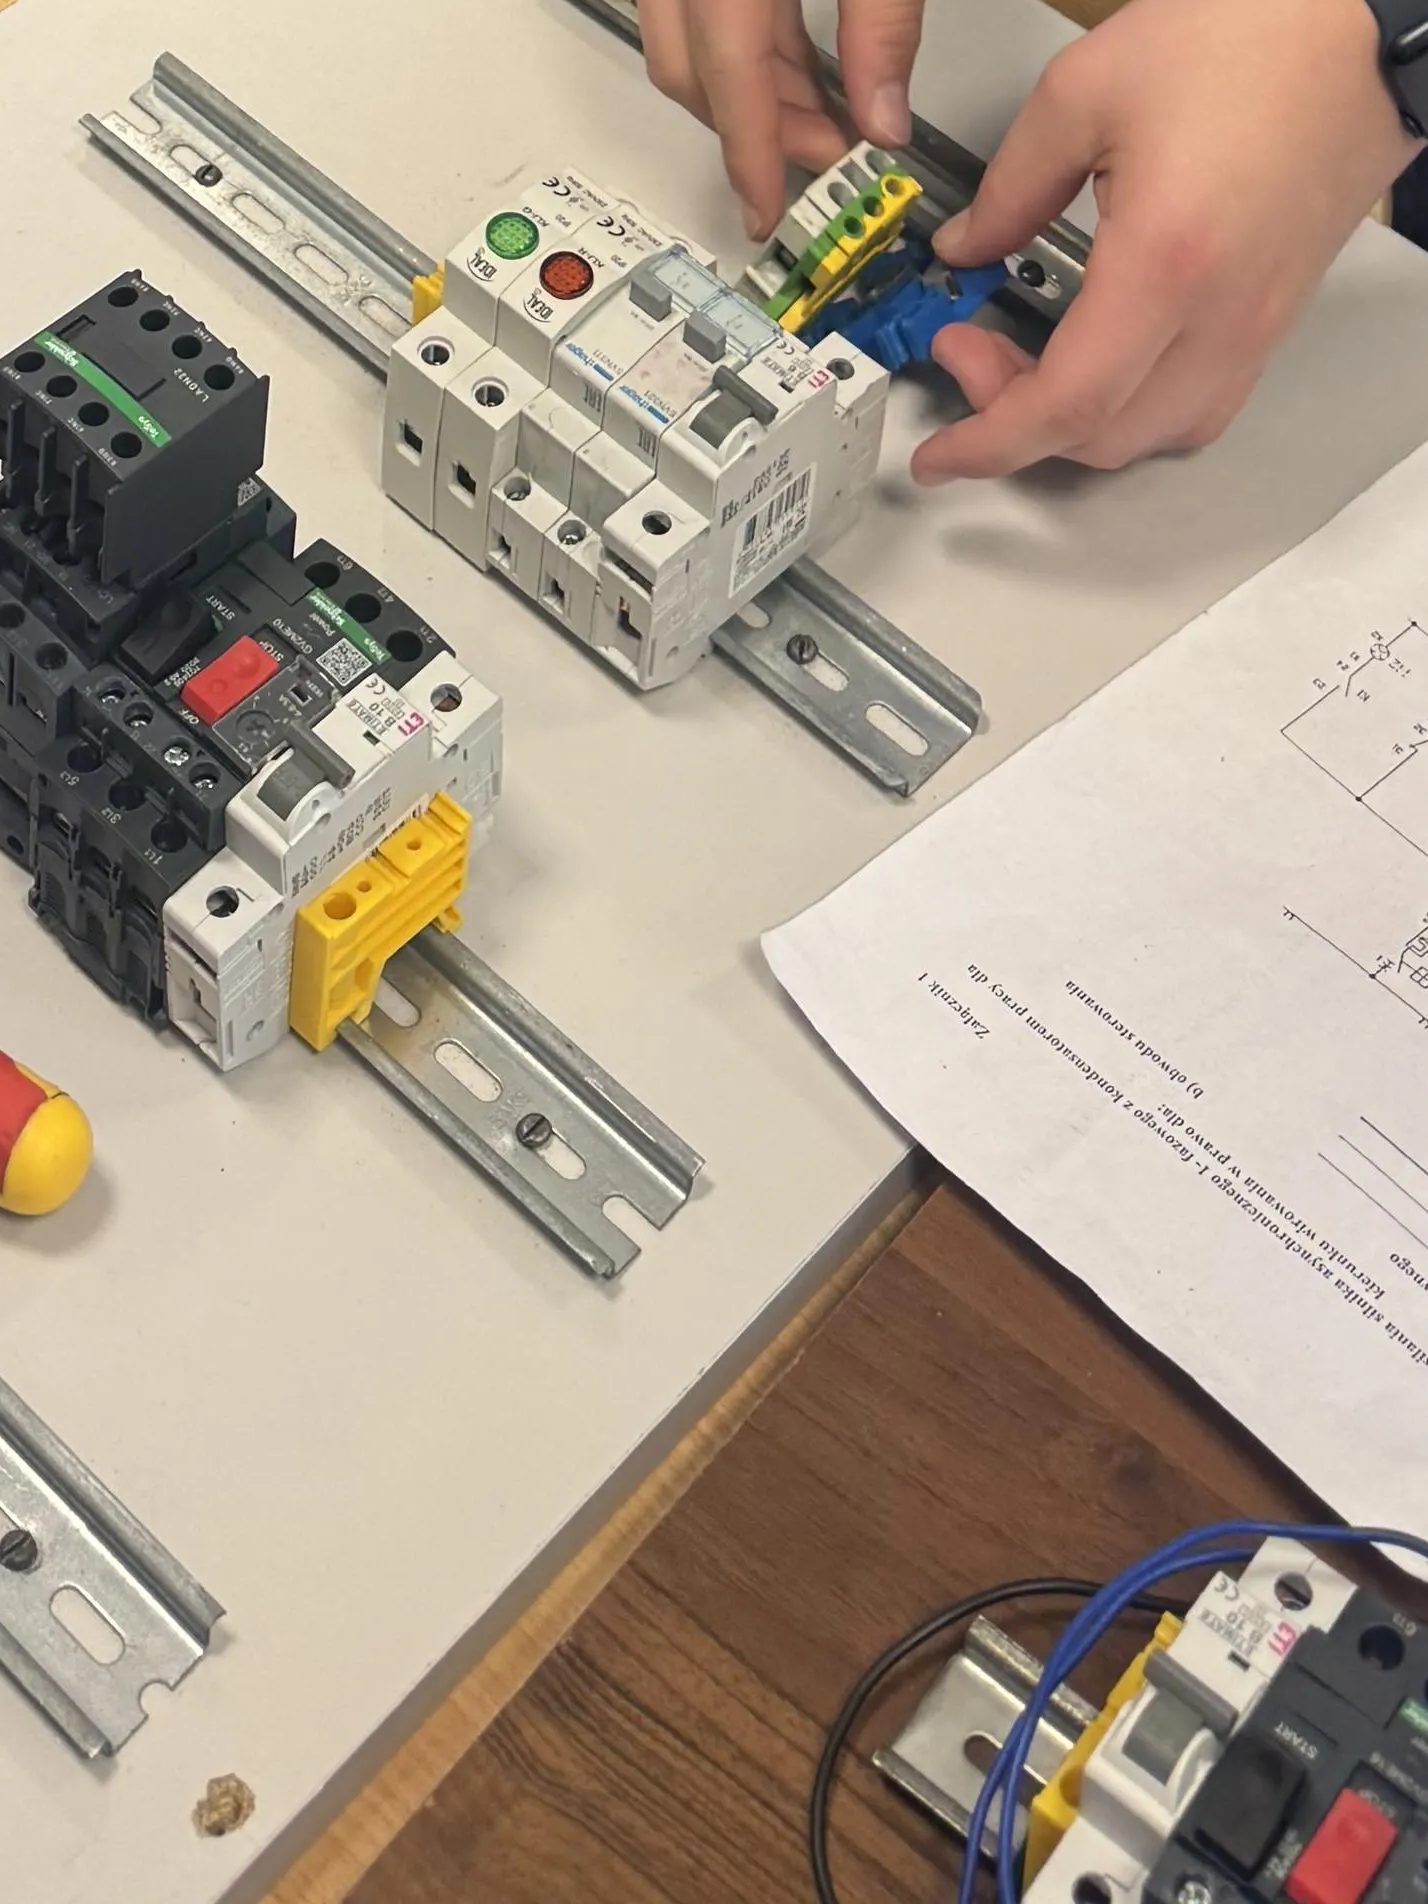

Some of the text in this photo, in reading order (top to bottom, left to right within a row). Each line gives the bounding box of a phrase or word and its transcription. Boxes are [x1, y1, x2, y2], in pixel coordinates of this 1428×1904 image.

[467, 251, 498, 280] IDEAL
[524, 292, 554, 320] IDEAL
[204, 592, 237, 620] START
[177, 705, 201, 726] OFF
[367, 699, 386, 717] 10
[395, 708, 425, 739] ETI
[968, 965, 988, 982] dla
[989, 984, 1028, 1016] pracy
[1066, 981, 1135, 1040] sterowania
[1026, 1016, 1123, 1103] kondensatorem
[1135, 1040, 1187, 1083] obwodu
[1134, 1110, 1194, 1161] fazowego
[1186, 1127, 1231, 1164] prawo
[1228, 1166, 1241, 1178] w
[1211, 1175, 1333, 1279] asynchronicznego
[1244, 1177, 1316, 1240] wirowania
[1319, 1240, 1385, 1299] kierunku
[1335, 1279, 1384, 1322] silnika
[1263, 1619, 1300, 1658] ETI
[1272, 1718, 1320, 1759] START
